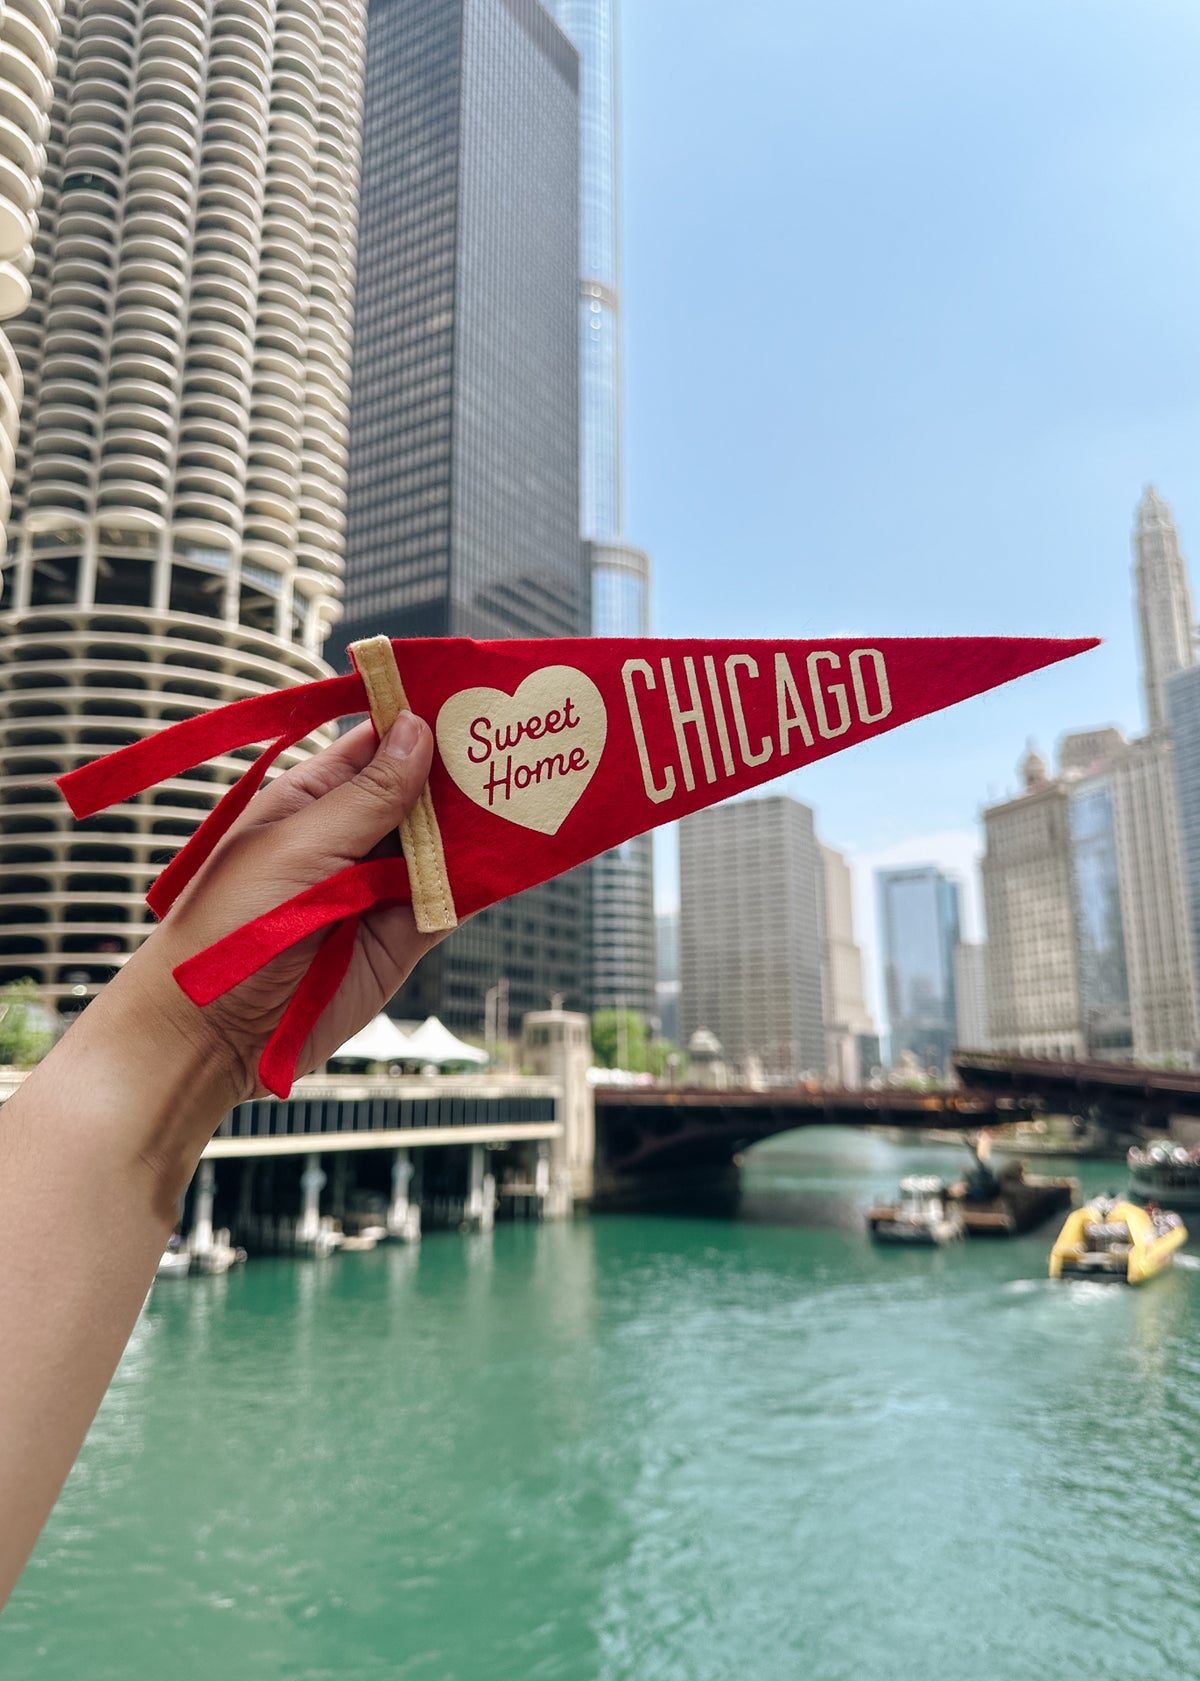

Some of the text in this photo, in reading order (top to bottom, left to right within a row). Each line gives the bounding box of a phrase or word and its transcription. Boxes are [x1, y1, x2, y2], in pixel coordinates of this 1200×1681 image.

[468, 698, 580, 763] Sweet
[621, 648, 892, 804] CHICAGO
[484, 746, 589, 805] Home
